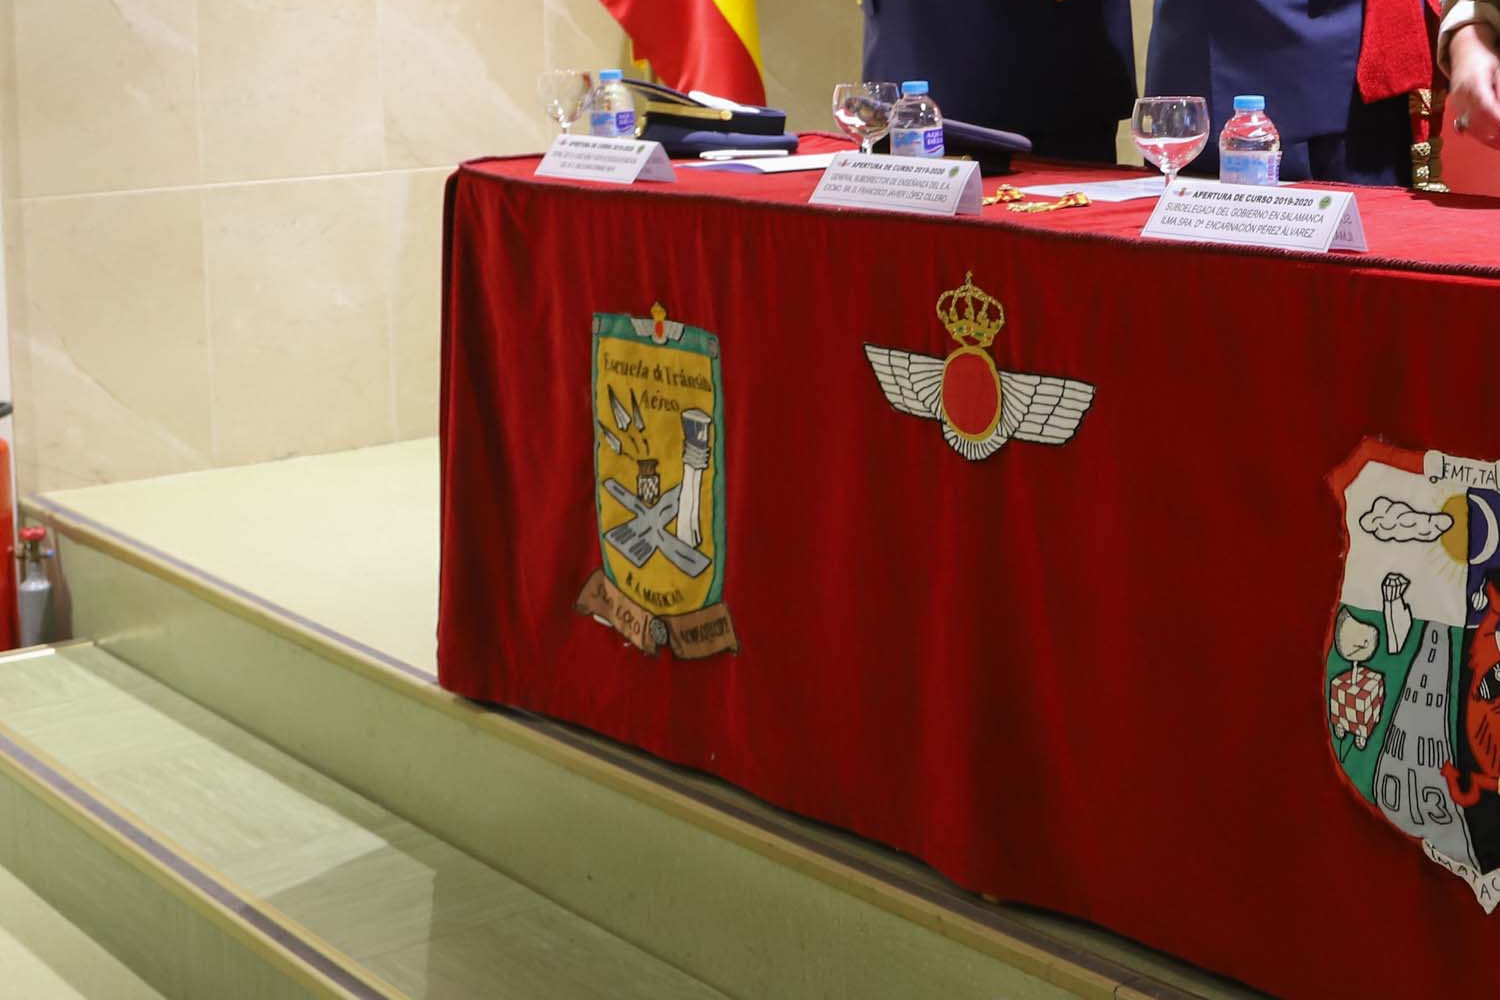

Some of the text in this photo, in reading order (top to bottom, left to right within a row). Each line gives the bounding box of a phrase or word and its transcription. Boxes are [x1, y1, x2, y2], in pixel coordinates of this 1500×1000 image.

[851, 161, 883, 170] APERTURA
[894, 165, 914, 173] CURSO
[1192, 191, 1314, 207] APERTURA DE CURSO 2019-2020
[1165, 202, 1216, 215] SUBDELEGADA
[1216, 206, 1230, 217] DEL
[1230, 207, 1269, 220] GOBIERNO
[1268, 211, 1280, 221] EN
[1279, 212, 1325, 224] SALAMANCA
[1204, 220, 1257, 233] ENCARNACIÓN
[1256, 223, 1281, 236] PÉREZ
[1280, 225, 1316, 238] ÁLVAREZ
[640, 389, 680, 412] Aéreo
